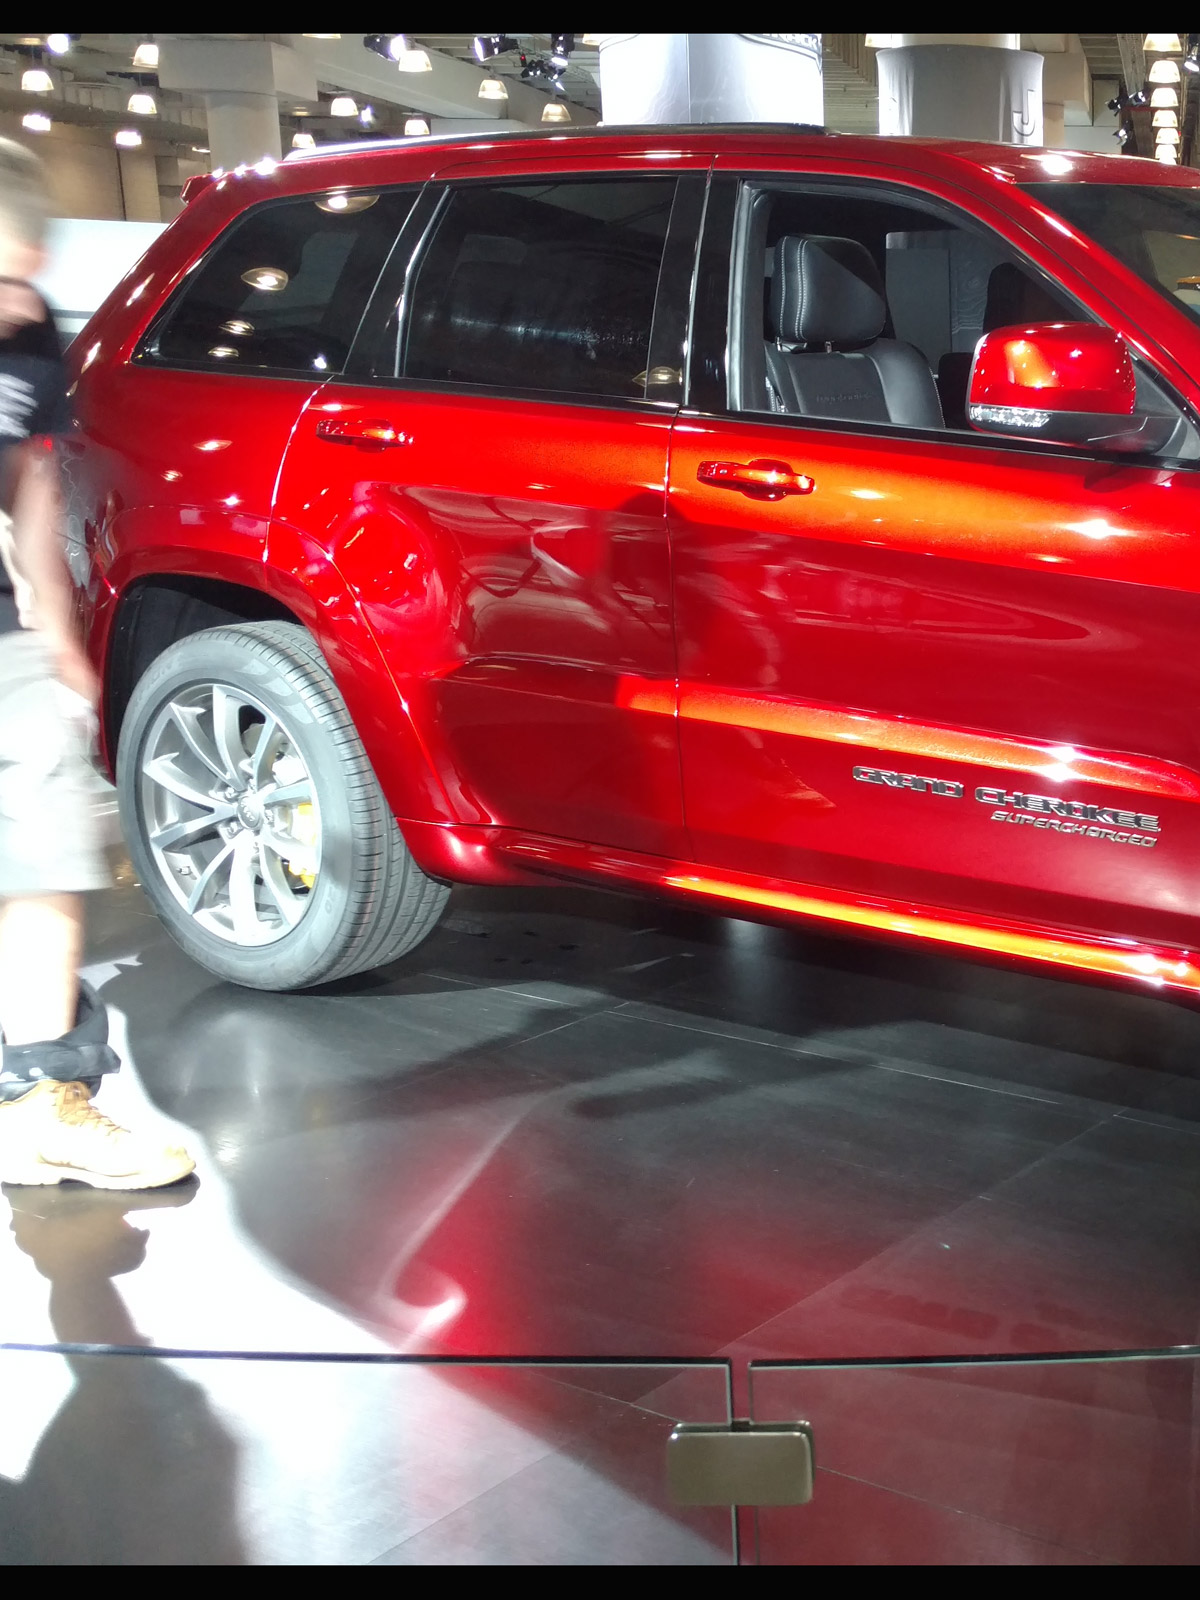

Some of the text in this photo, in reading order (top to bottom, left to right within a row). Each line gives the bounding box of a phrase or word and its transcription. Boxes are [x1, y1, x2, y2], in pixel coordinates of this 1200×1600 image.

[852, 765, 1162, 832] GRAND CHEROKEE
[990, 810, 1158, 848] SUPERCHARGED
